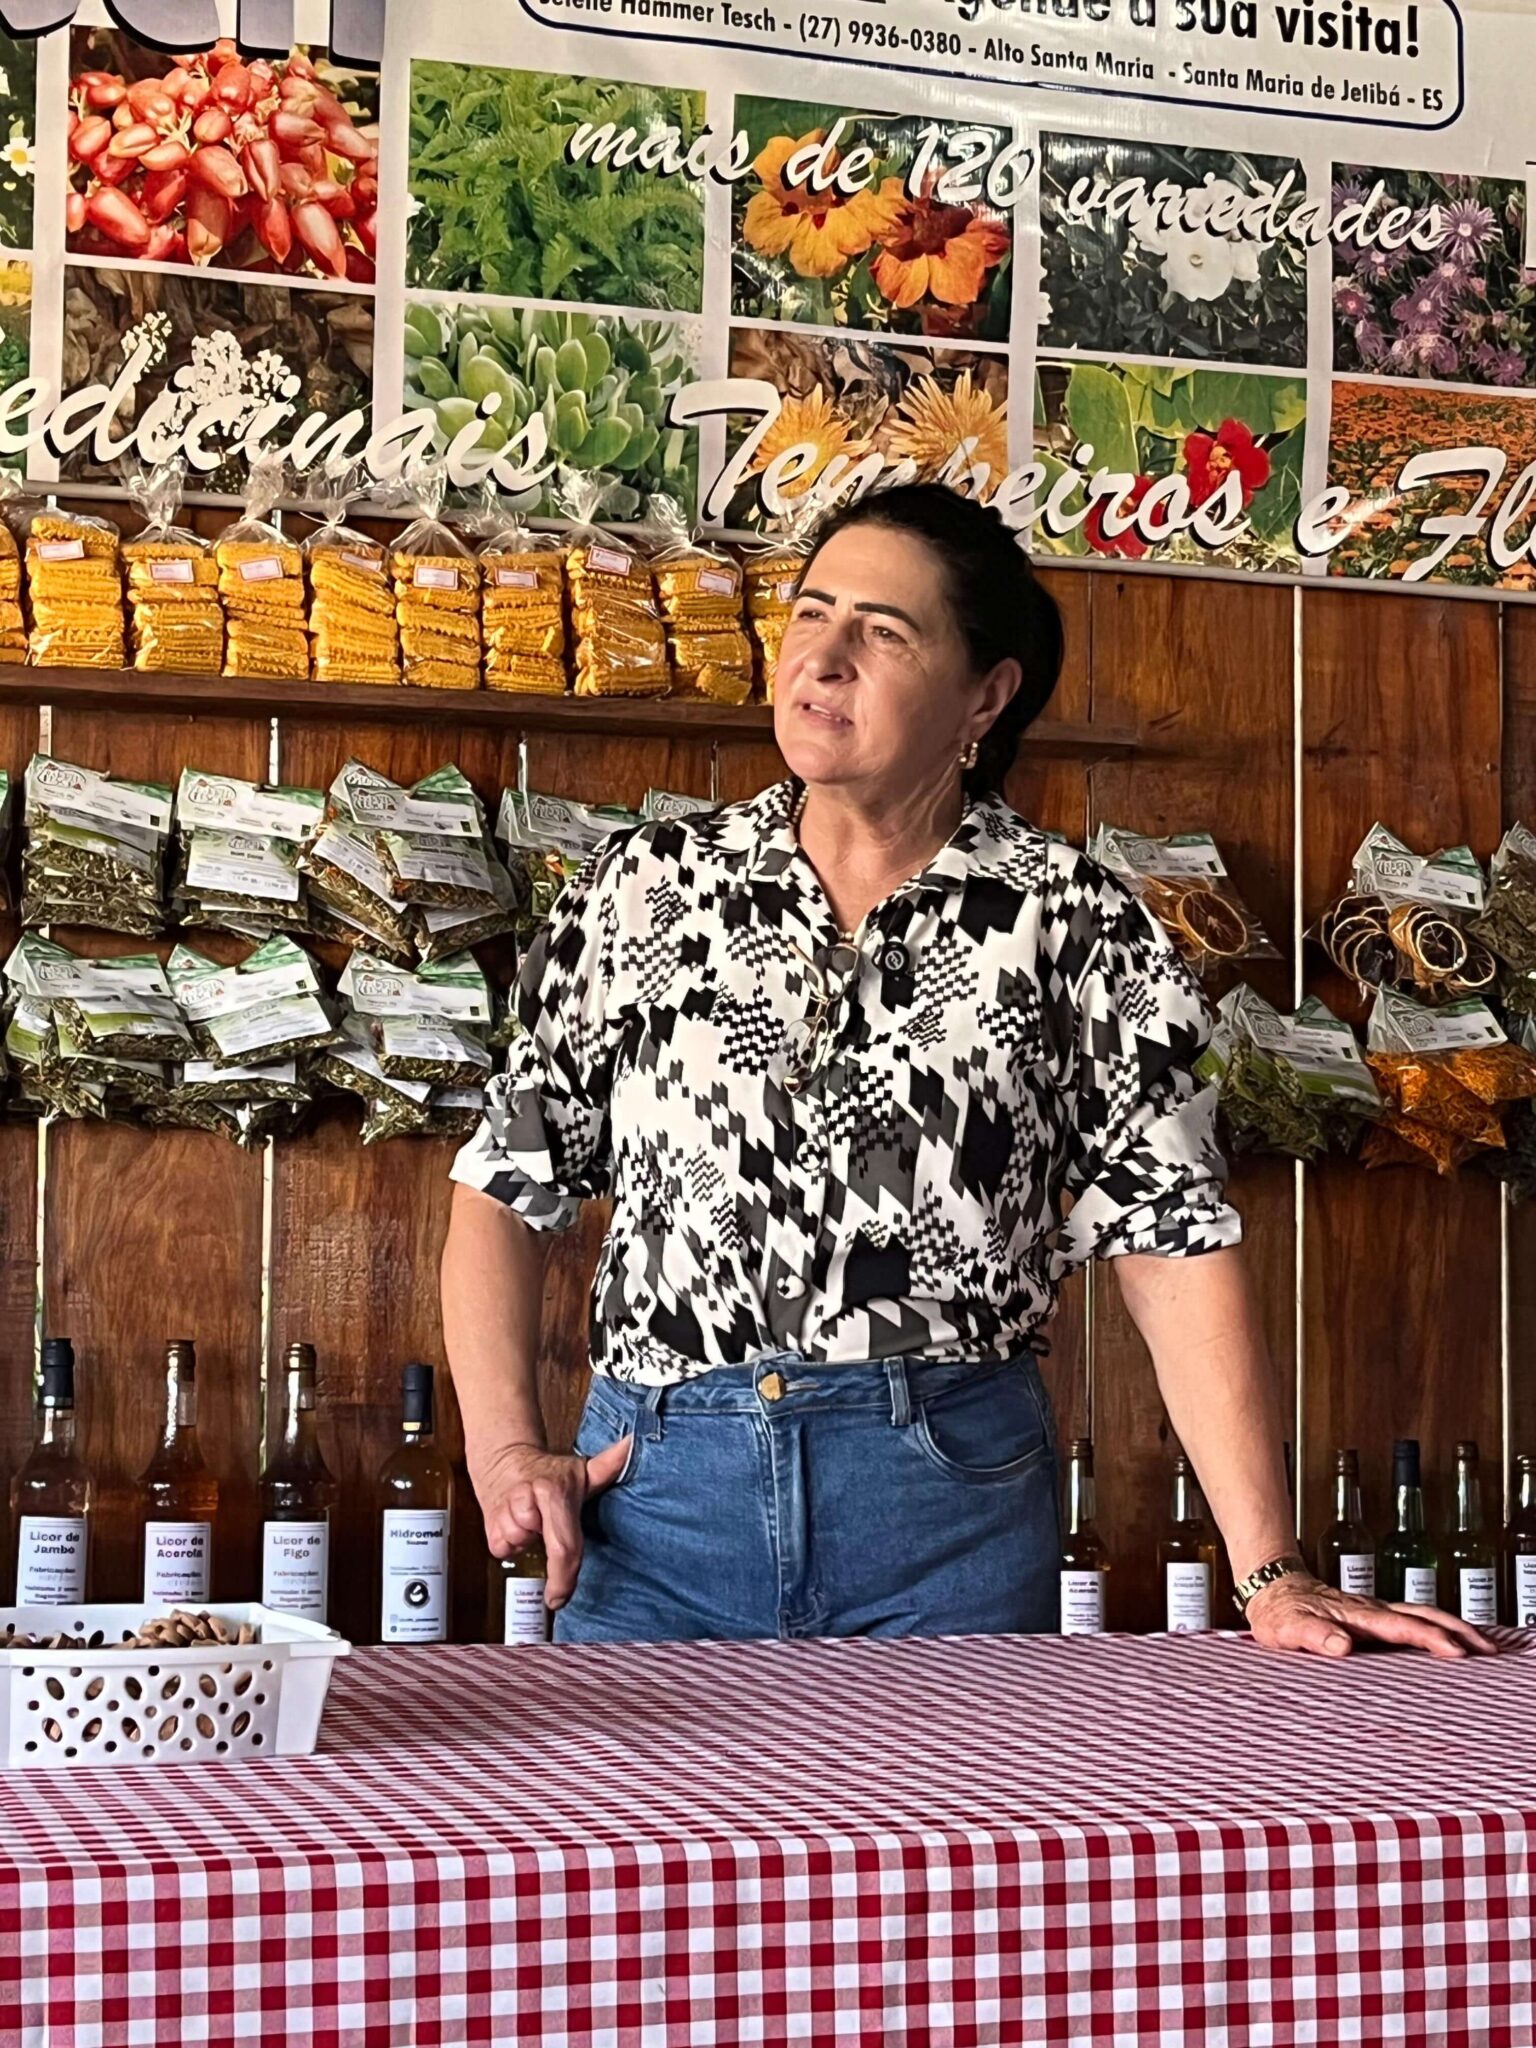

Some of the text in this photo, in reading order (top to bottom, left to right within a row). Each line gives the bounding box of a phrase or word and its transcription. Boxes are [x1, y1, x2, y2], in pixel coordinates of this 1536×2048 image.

[1175, 0, 1257, 38] sua
[1275, 0, 1419, 57] visita!
[540, 0, 612, 12] ene
[621, 0, 714, 23] Hammer
[722, 3, 776, 32] Tesch
[800, 13, 840, 47] (27)
[848, 20, 961, 55] 9936-0380
[984, 38, 1024, 64] Alto
[1031, 44, 1088, 72] Santa
[1096, 51, 1154, 79] Maria
[1184, 62, 1238, 90] Santa
[1246, 69, 1303, 97] Maria
[1311, 75, 1335, 99] de
[1341, 79, 1400, 107] Jetibá
[1423, 88, 1443, 111] ES
[568, 116, 1443, 252] mais de 120 variedades
[0, 327, 557, 493] edicinais
[1297, 485, 1352, 555] e
[1398, 447, 1536, 581] Fl
[30, 1531, 80, 1542] Licor de
[390, 1528, 444, 1539] Hidromel
[156, 1536, 204, 1546] Licor de
[273, 1535, 321, 1545] Licor de
[33, 1544, 75, 1554] Jambo
[157, 1548, 203, 1558] Acerola
[283, 1548, 310, 1559] Figo
